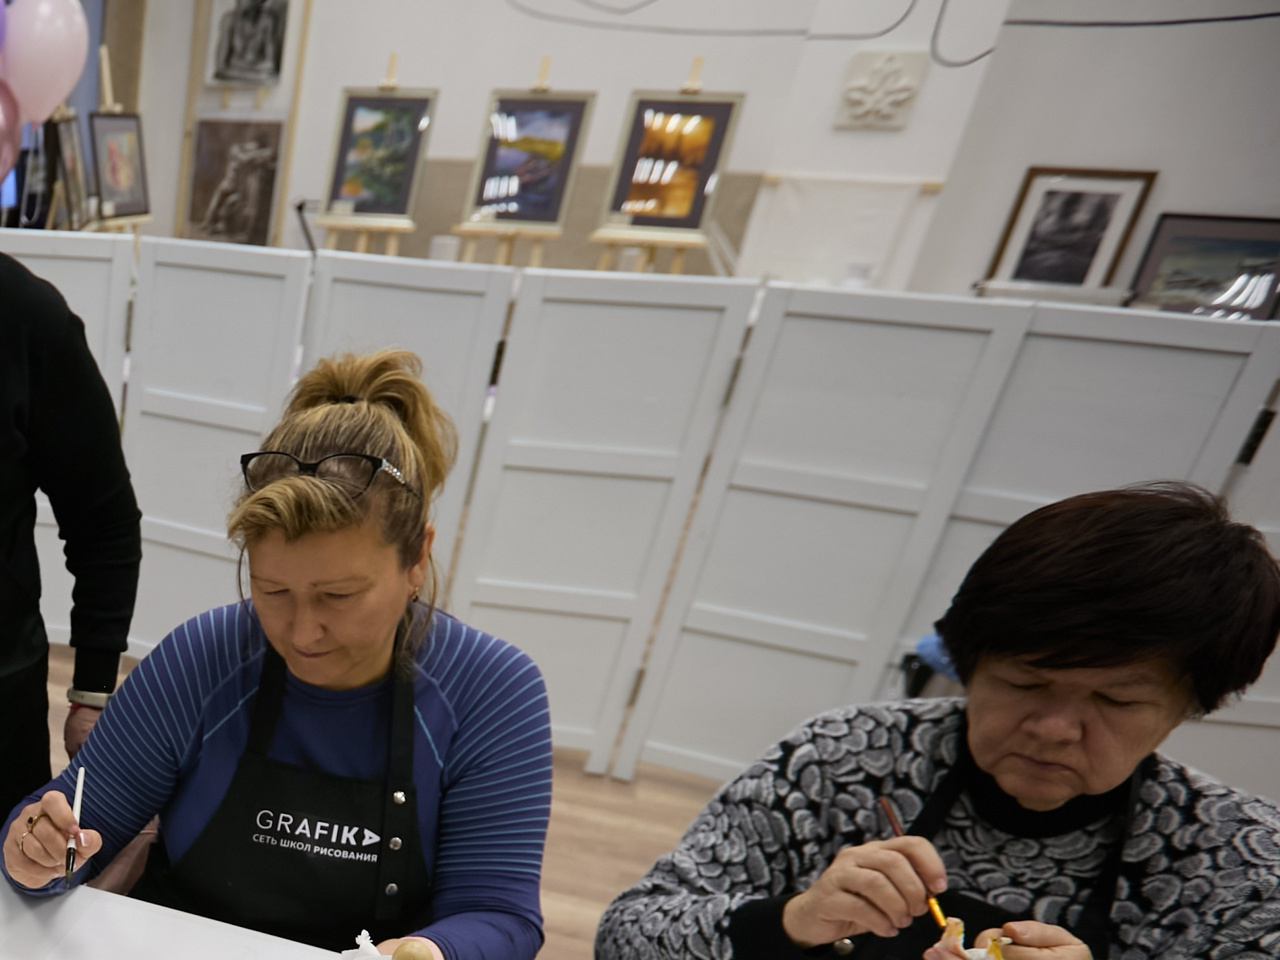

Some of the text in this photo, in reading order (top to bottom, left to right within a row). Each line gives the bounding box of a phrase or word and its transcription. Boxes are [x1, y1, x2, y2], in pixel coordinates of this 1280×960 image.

[252, 833, 379, 863] СЕТЬ ШКОЛ РИСОВАНИЯ
